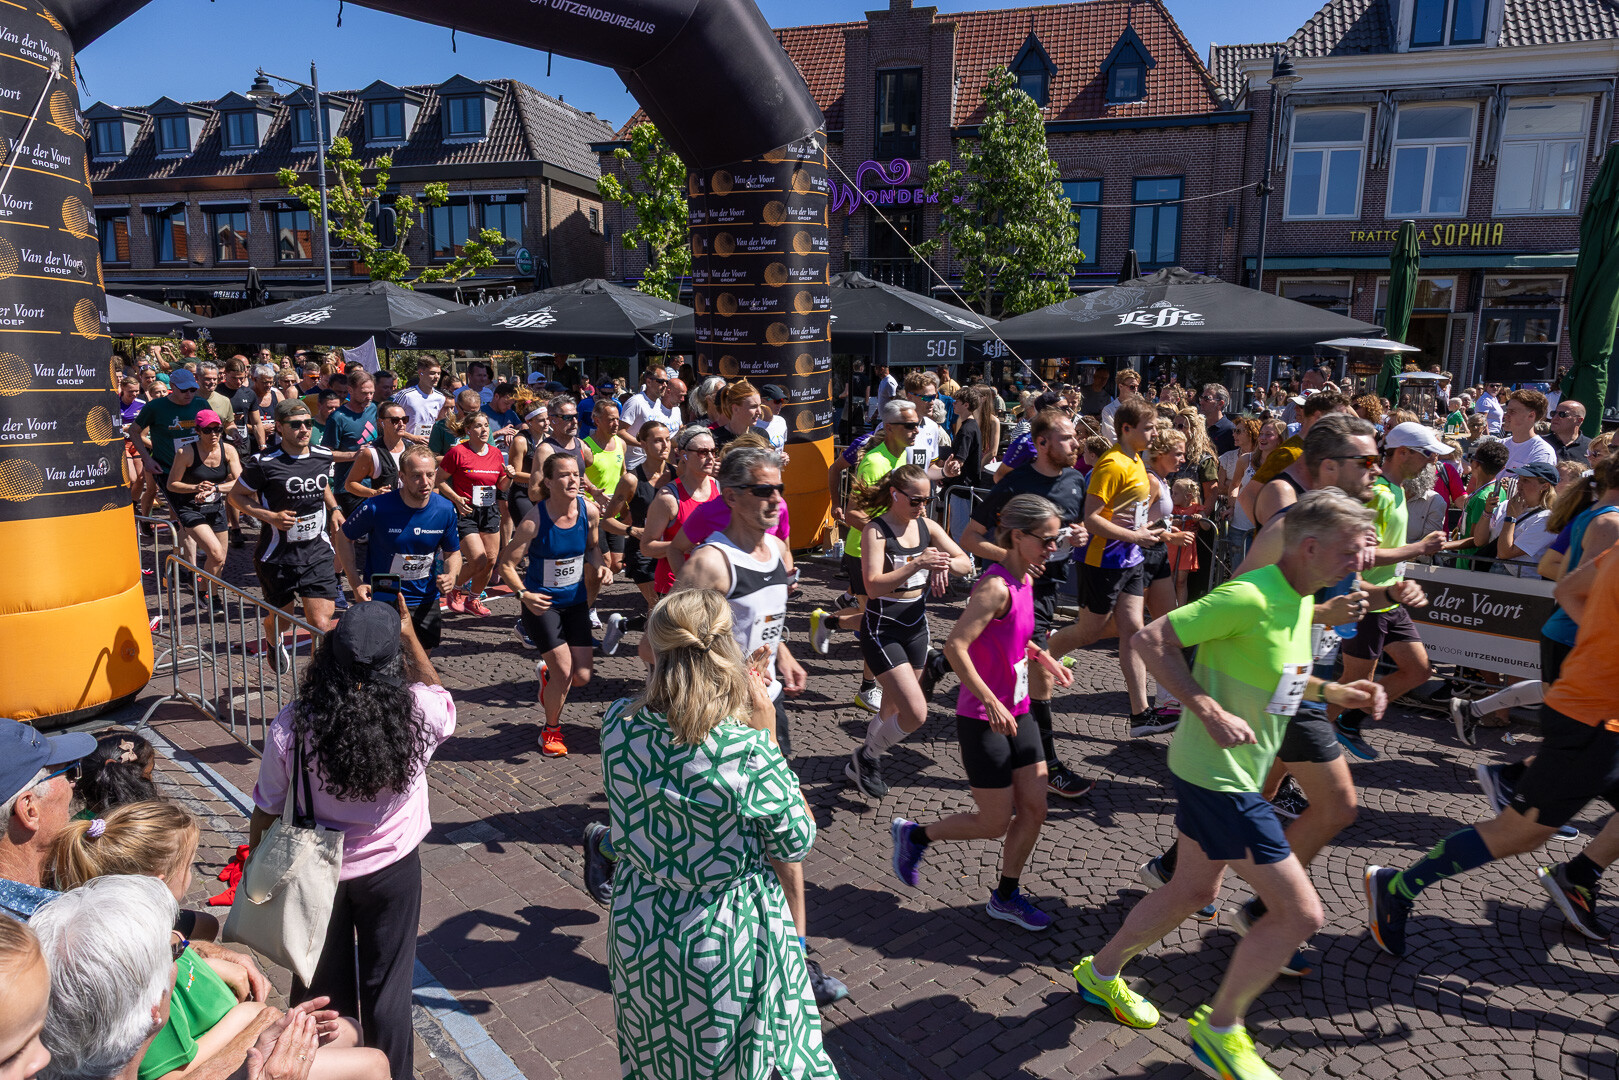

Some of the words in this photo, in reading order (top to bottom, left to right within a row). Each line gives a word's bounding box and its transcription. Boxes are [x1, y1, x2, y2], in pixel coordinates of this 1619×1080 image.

[551, 0, 656, 34] UITZENDBUREAUS
[22, 33, 38, 49] der
[20, 48, 48, 61] GROEP
[0, 87, 21, 101] oort
[33, 143, 49, 158] der
[51, 147, 71, 165] Voort
[31, 158, 59, 169] GROEP
[759, 174, 775, 183] Voort
[2, 193, 33, 210] Voort
[729, 208, 745, 217] Voort
[760, 237, 777, 246] Voort
[1350, 230, 1427, 242] TRATTOA
[1431, 223, 1504, 246] SOPHIA
[21, 249, 42, 264] Van
[45, 251, 61, 266] der
[43, 266, 71, 275] GROEP
[731, 268, 747, 277] Voort
[761, 297, 778, 306] Voort
[0, 307, 10, 317] er
[13, 304, 45, 318] Voort
[1114, 307, 1205, 328] Leffe
[733, 327, 749, 336] Voort
[926, 340, 957, 357] 5:06
[34, 363, 55, 377] Van
[57, 363, 74, 377] der
[75, 364, 96, 378] Voort
[762, 361, 779, 369] Voort
[2, 418, 24, 432] der
[26, 417, 58, 432] Voort
[0, 433, 38, 441] GROEP
[45, 467, 67, 481] Van
[69, 465, 87, 480] der
[68, 479, 95, 487] GROEP
[297, 522, 317, 532] 282
[402, 563, 425, 571] 664
[554, 566, 575, 577] 365
[1433, 588, 1465, 610] der
[1471, 592, 1523, 620] Voort
[1428, 610, 1484, 627] GROEP
[1439, 645, 1462, 656] VOOR
[1464, 650, 1542, 670] UITZENDBUREAU
